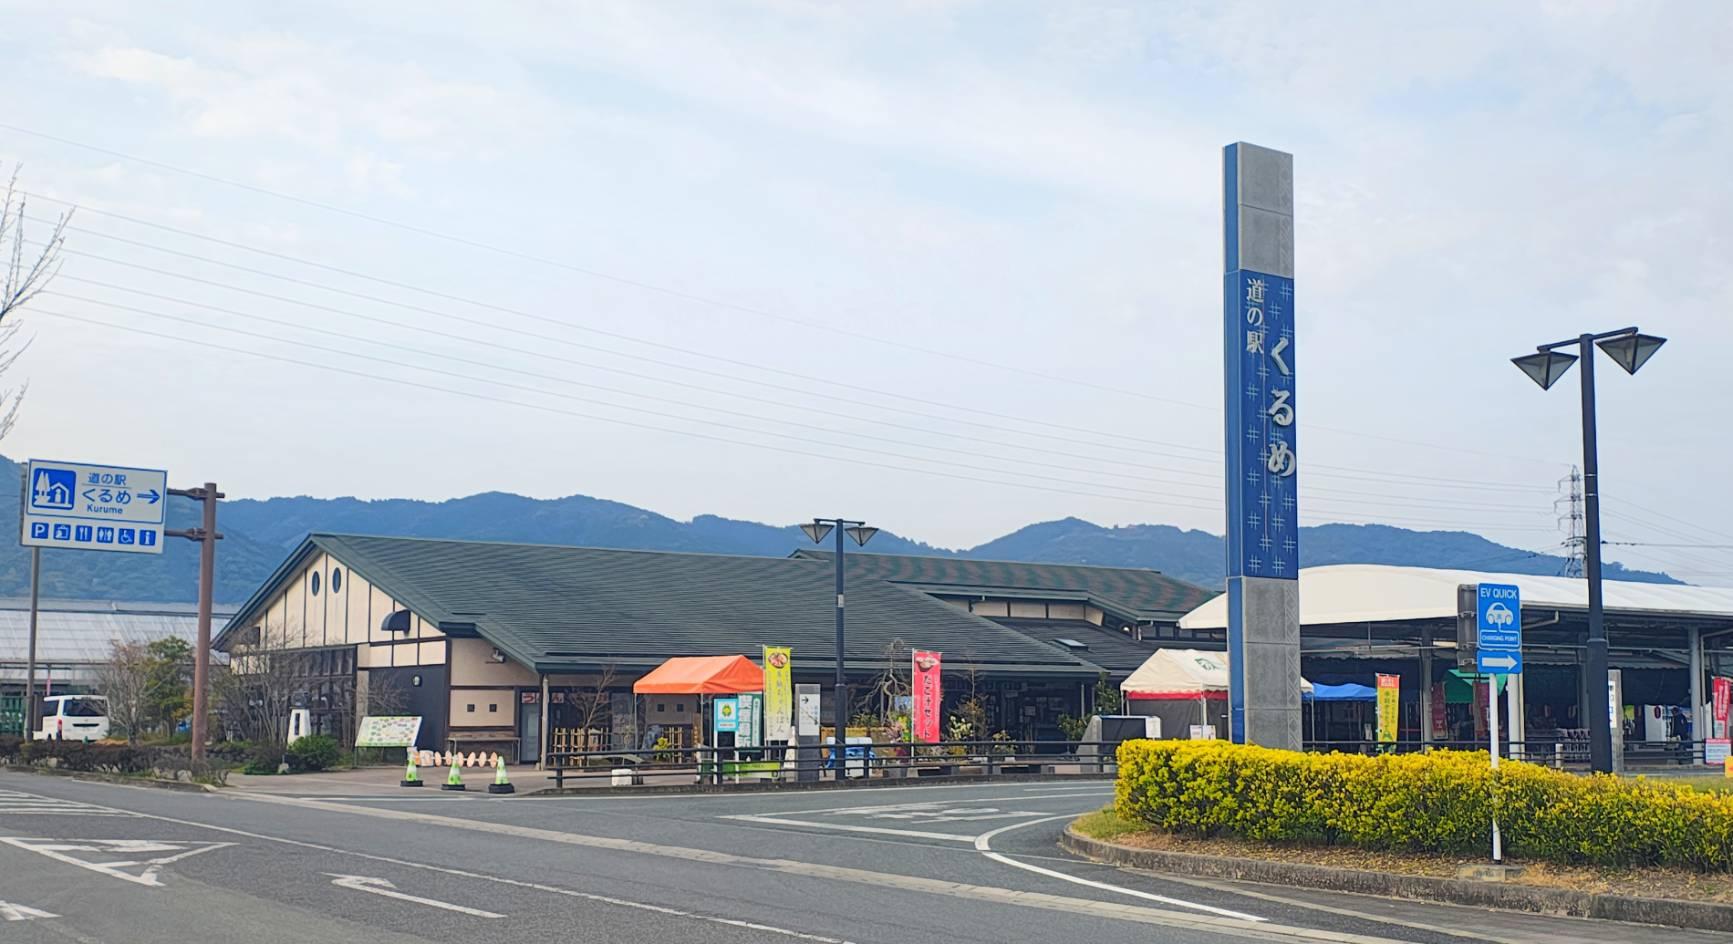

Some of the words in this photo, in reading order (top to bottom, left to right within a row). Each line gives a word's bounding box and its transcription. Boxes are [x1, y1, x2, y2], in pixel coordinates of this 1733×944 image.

[1246, 278, 1264, 354] 道の駅
[1268, 337, 1296, 478] くるめ
[88, 472, 127, 486] 道の駅
[82, 488, 131, 505] くるめ
[87, 504, 123, 514] Kurume
[1481, 588, 1491, 598] EV
[1493, 588, 1517, 600] QUICK
